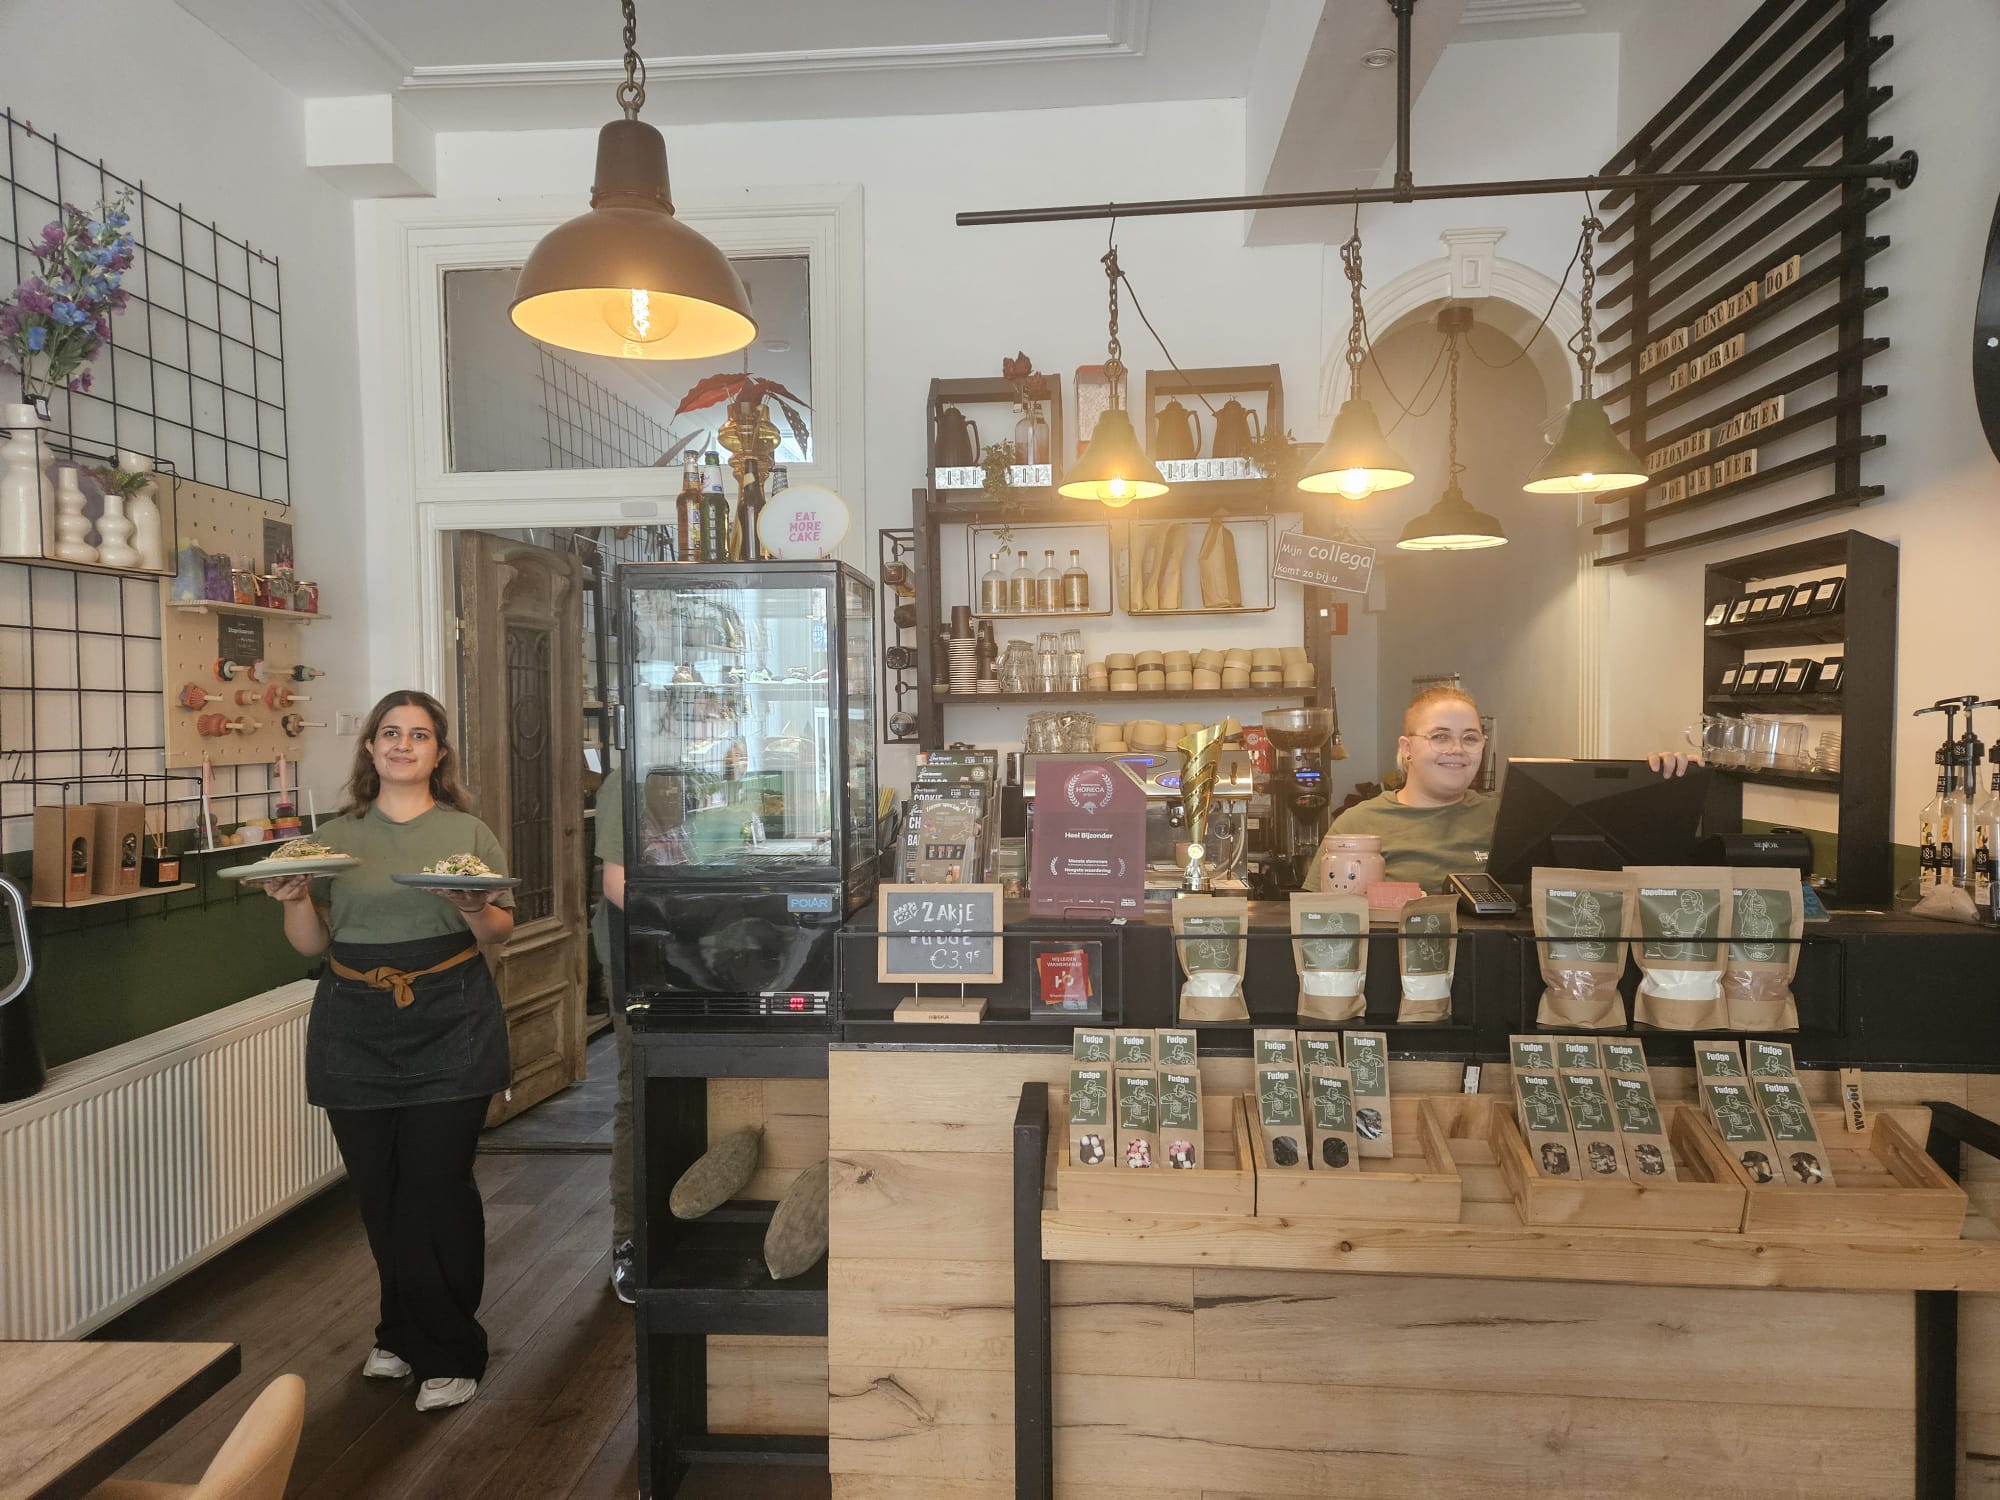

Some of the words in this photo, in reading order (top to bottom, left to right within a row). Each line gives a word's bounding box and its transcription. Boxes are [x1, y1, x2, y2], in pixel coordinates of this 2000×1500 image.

[1640, 331, 1685, 370] GEWOON
[1695, 287, 1753, 339] LUNCHEN
[1766, 261, 1794, 295] DOE
[1691, 341, 1739, 380] OVERAL
[1647, 433, 1706, 471] IJZONDER
[1660, 478, 1682, 501] DOE
[1690, 469, 1707, 491] JE
[1714, 455, 1753, 484] HIER
[795, 512, 817, 521] EAT
[789, 521, 822, 532] MORE
[789, 531, 820, 543] CAKE
[1281, 543, 1302, 557] Mijn
[1308, 543, 1372, 571] collega
[1277, 563, 1301, 575] komt
[1302, 569, 1314, 579] zo
[1316, 570, 1329, 584] bij
[1331, 575, 1338, 583] u
[1081, 832, 1113, 840] Bijzonder
[1549, 889, 1577, 898] Brownie
[1640, 888, 1677, 897] Appeltaart
[1083, 1035, 1104, 1044] Fudge
[1123, 1036, 1144, 1045] Fudge
[1166, 1035, 1188, 1044] Fudge
[1354, 1037, 1376, 1047] Fudge
[1264, 1041, 1286, 1050] Fudge
[1307, 1041, 1329, 1049] Fudge
[1520, 1043, 1543, 1052] Fudge
[1565, 1043, 1589, 1053] Fudge
[1610, 1045, 1633, 1054] Fudge
[1758, 1044, 1782, 1056] Fudge
[1706, 1052, 1730, 1061] Fudge
[1079, 1071, 1101, 1079] Fudge
[1168, 1074, 1190, 1084] Fudge
[1267, 1072, 1289, 1080] Fudge
[1127, 1078, 1149, 1086] Fudge
[1320, 1078, 1342, 1088] Fudge
[1524, 1076, 1548, 1085] Fudge
[1569, 1076, 1594, 1085] Fudge
[1617, 1079, 1641, 1089] Fudge
[1713, 1086, 1739, 1095] Fudge
[1764, 1083, 1790, 1093] Fudge
